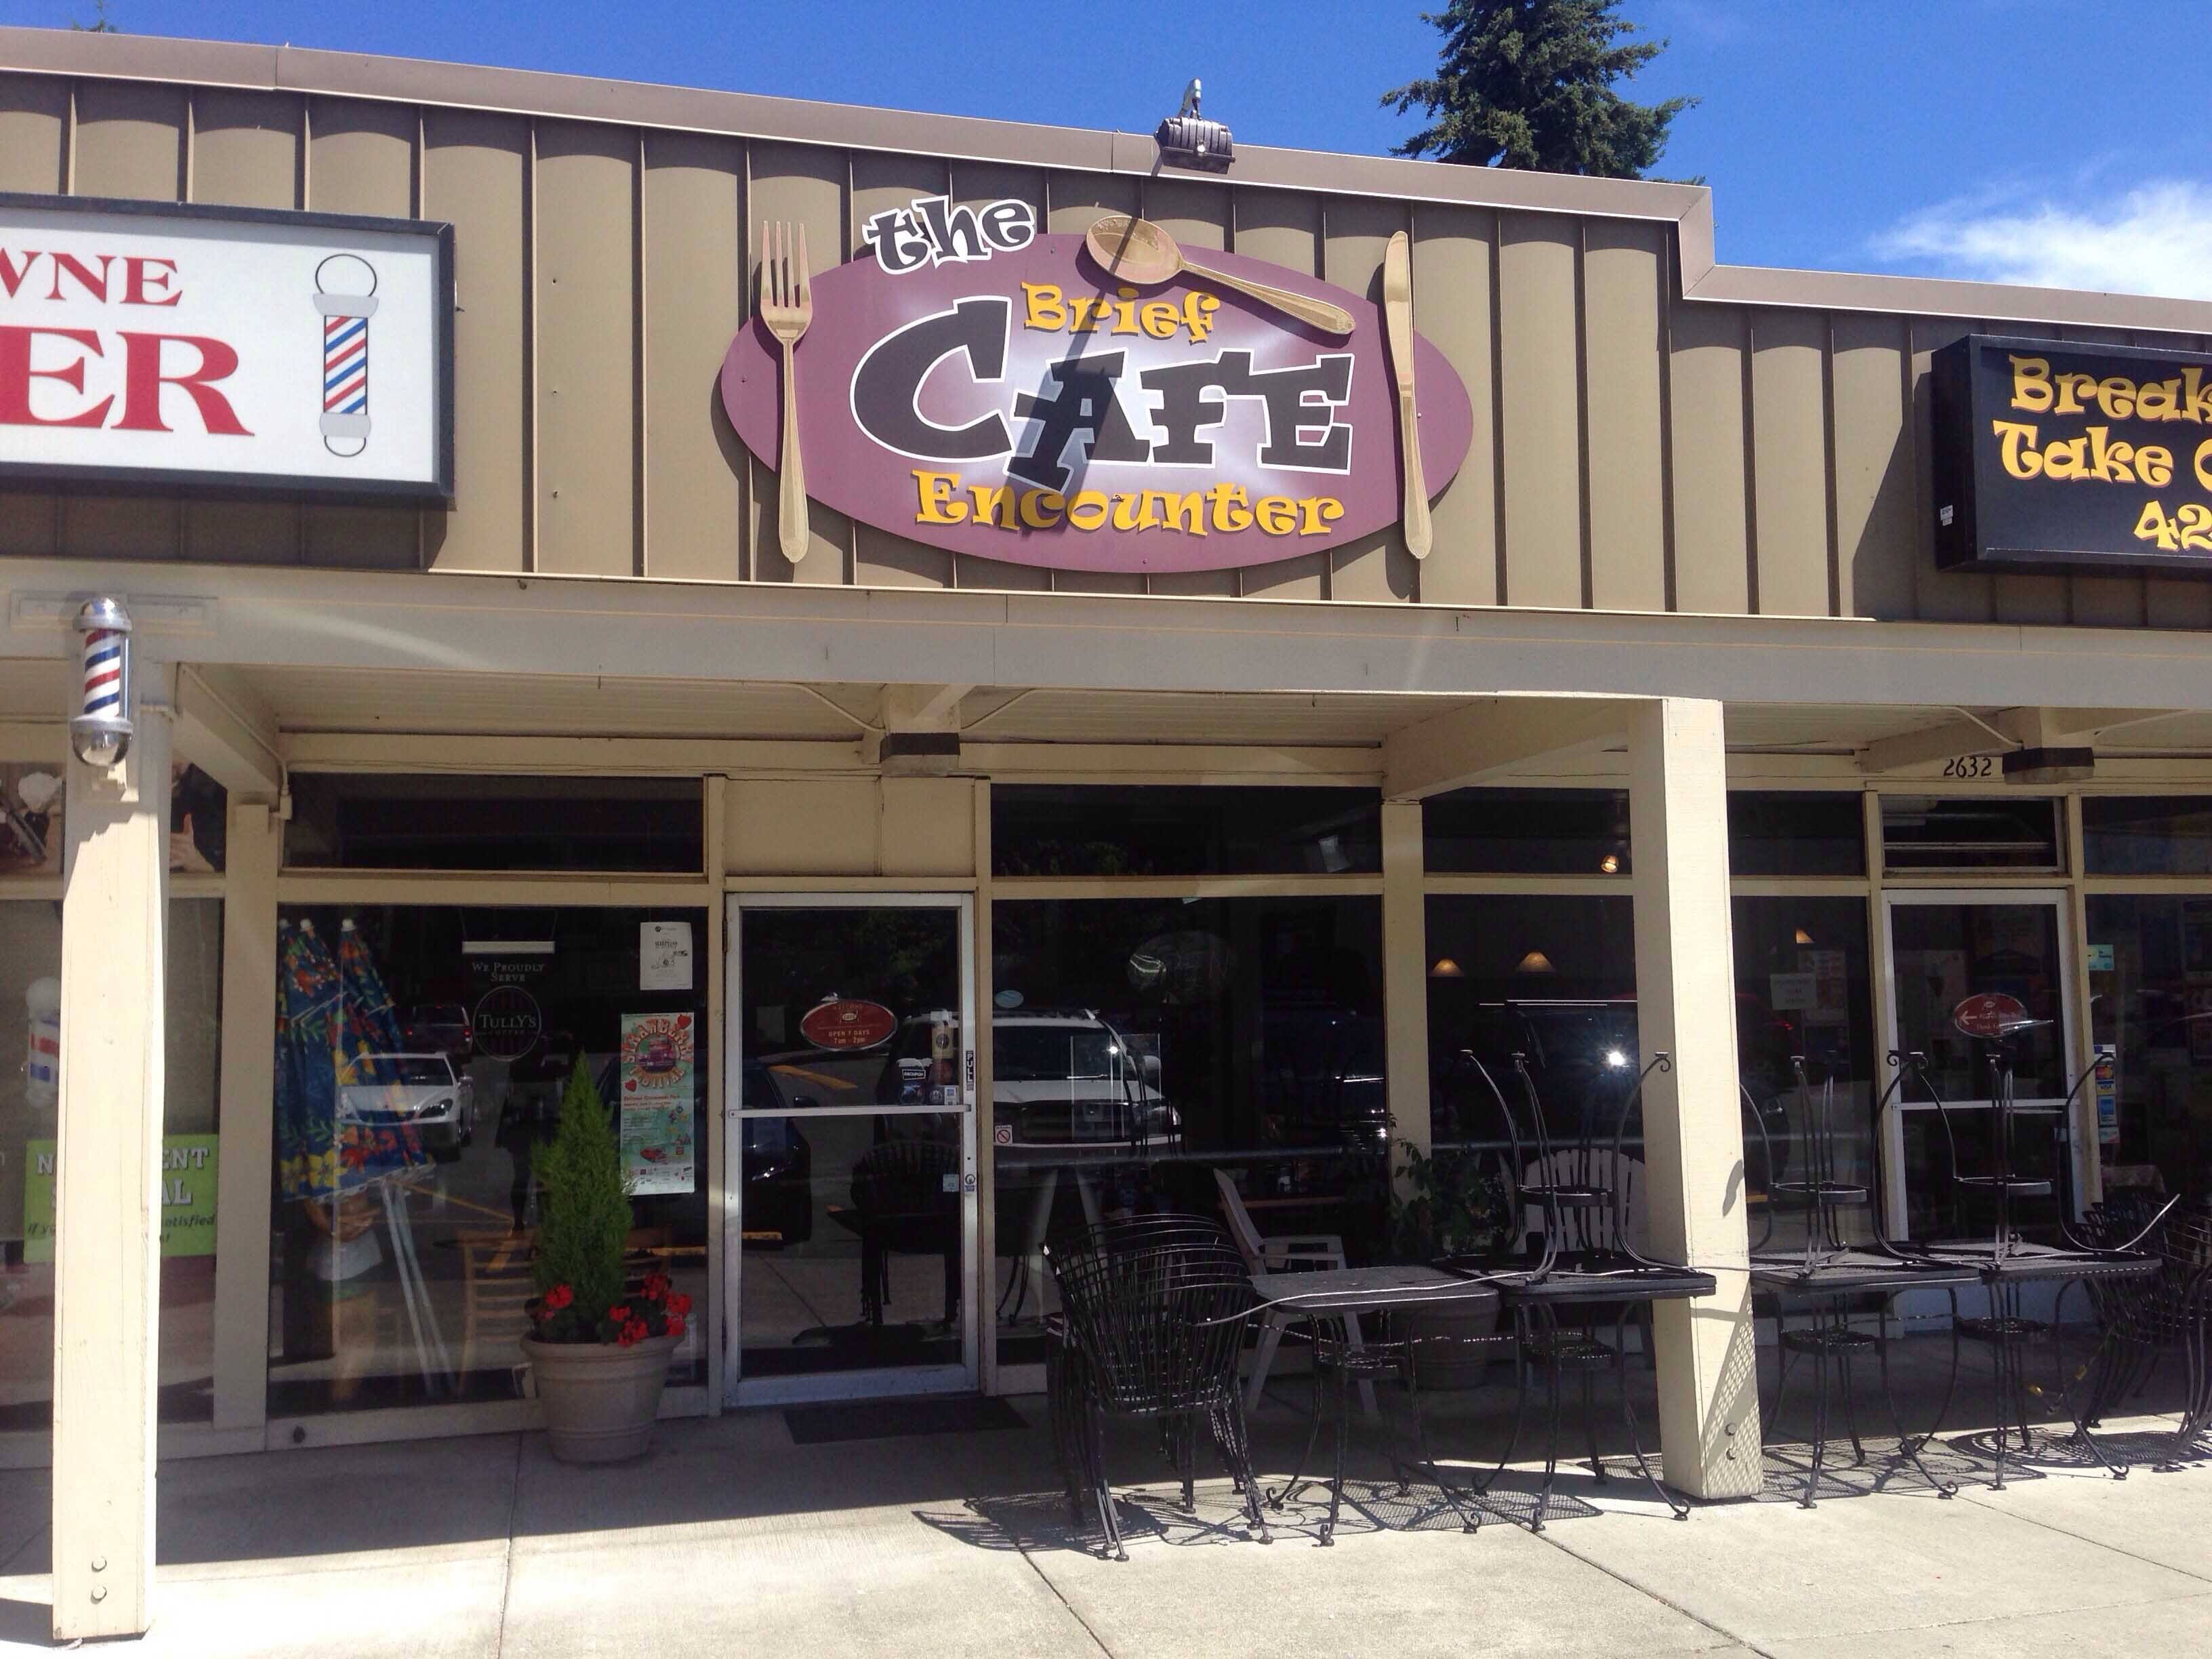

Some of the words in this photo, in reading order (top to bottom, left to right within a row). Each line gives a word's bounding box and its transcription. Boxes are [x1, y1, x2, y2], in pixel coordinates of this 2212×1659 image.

[863, 195, 1036, 274] the
[1021, 282, 1221, 344] Brief
[0, 324, 255, 437] ER
[849, 295, 1355, 494] CAFE
[1992, 419, 2174, 487] Take
[912, 470, 1345, 537] Encounter
[1943, 756, 1992, 778] 2632
[478, 1014, 537, 1029] TULLY'S
[163, 1213, 215, 1228] atisfied
